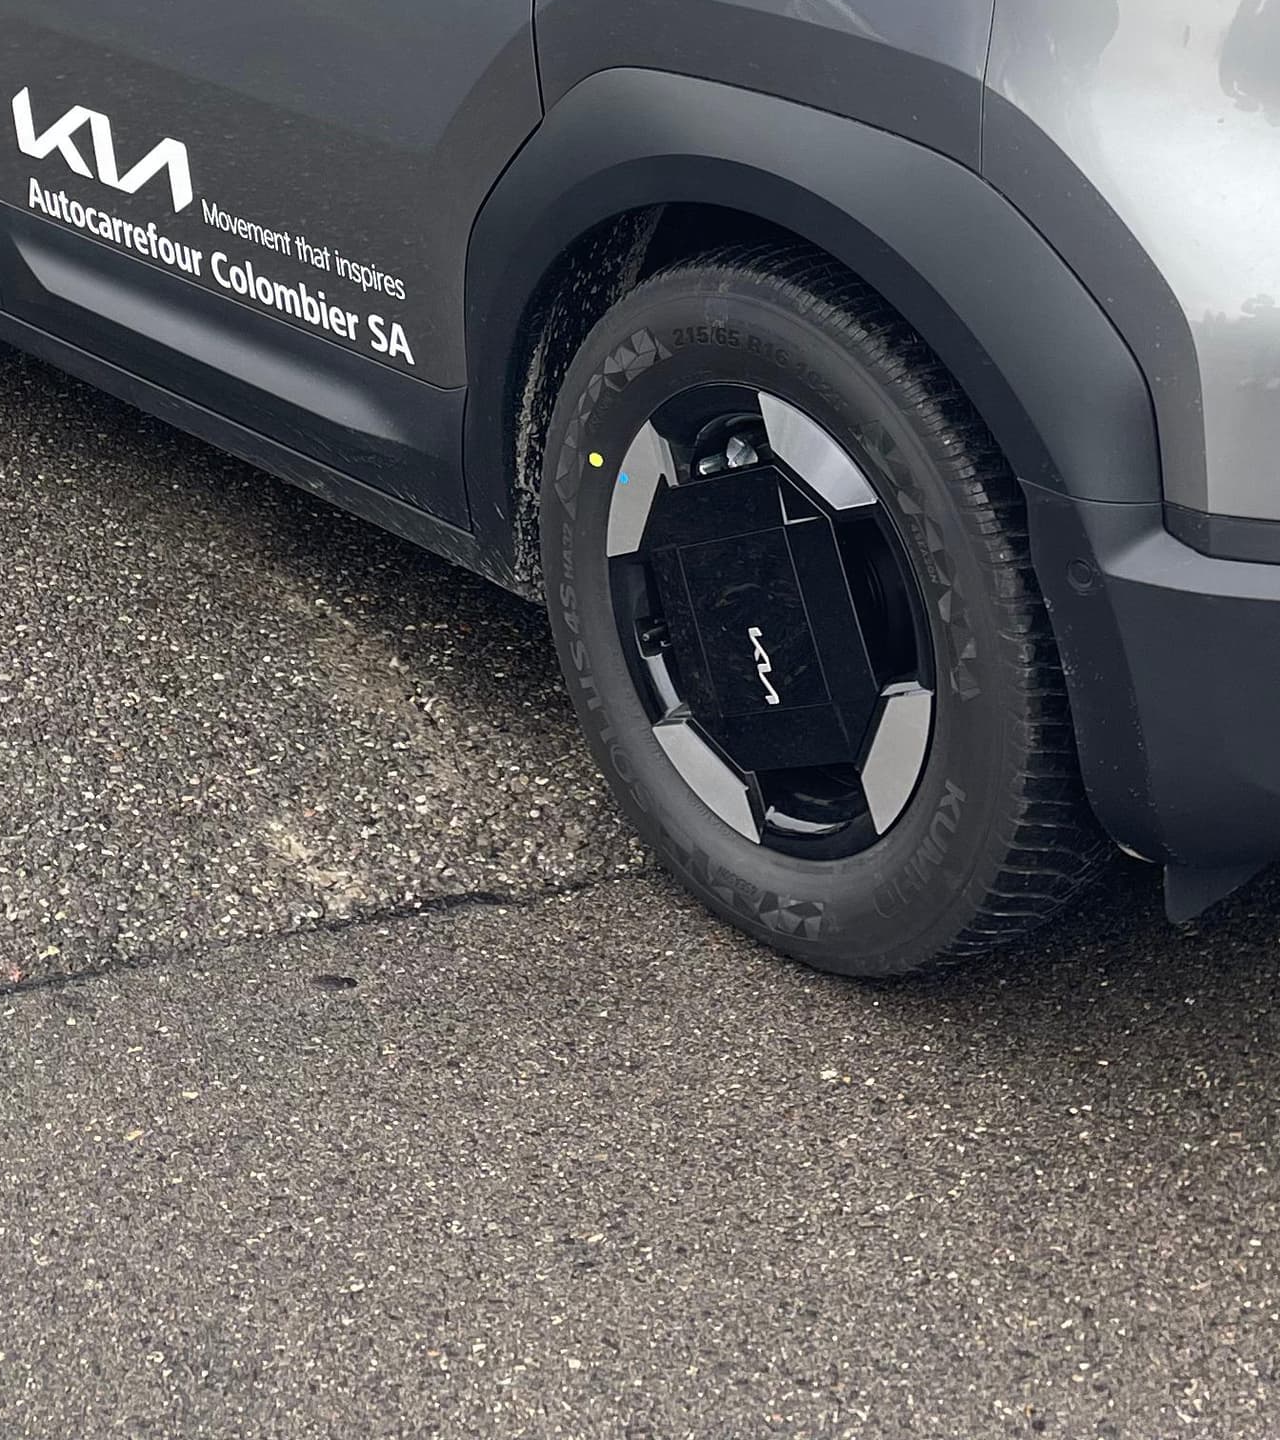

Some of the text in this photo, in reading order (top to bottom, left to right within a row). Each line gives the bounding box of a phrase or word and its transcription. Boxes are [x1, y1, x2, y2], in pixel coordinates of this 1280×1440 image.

[11, 86, 194, 213] KIA
[28, 176, 416, 366] Autocarrefour Colombier SA
[201, 198, 407, 300] Movement that inspires
